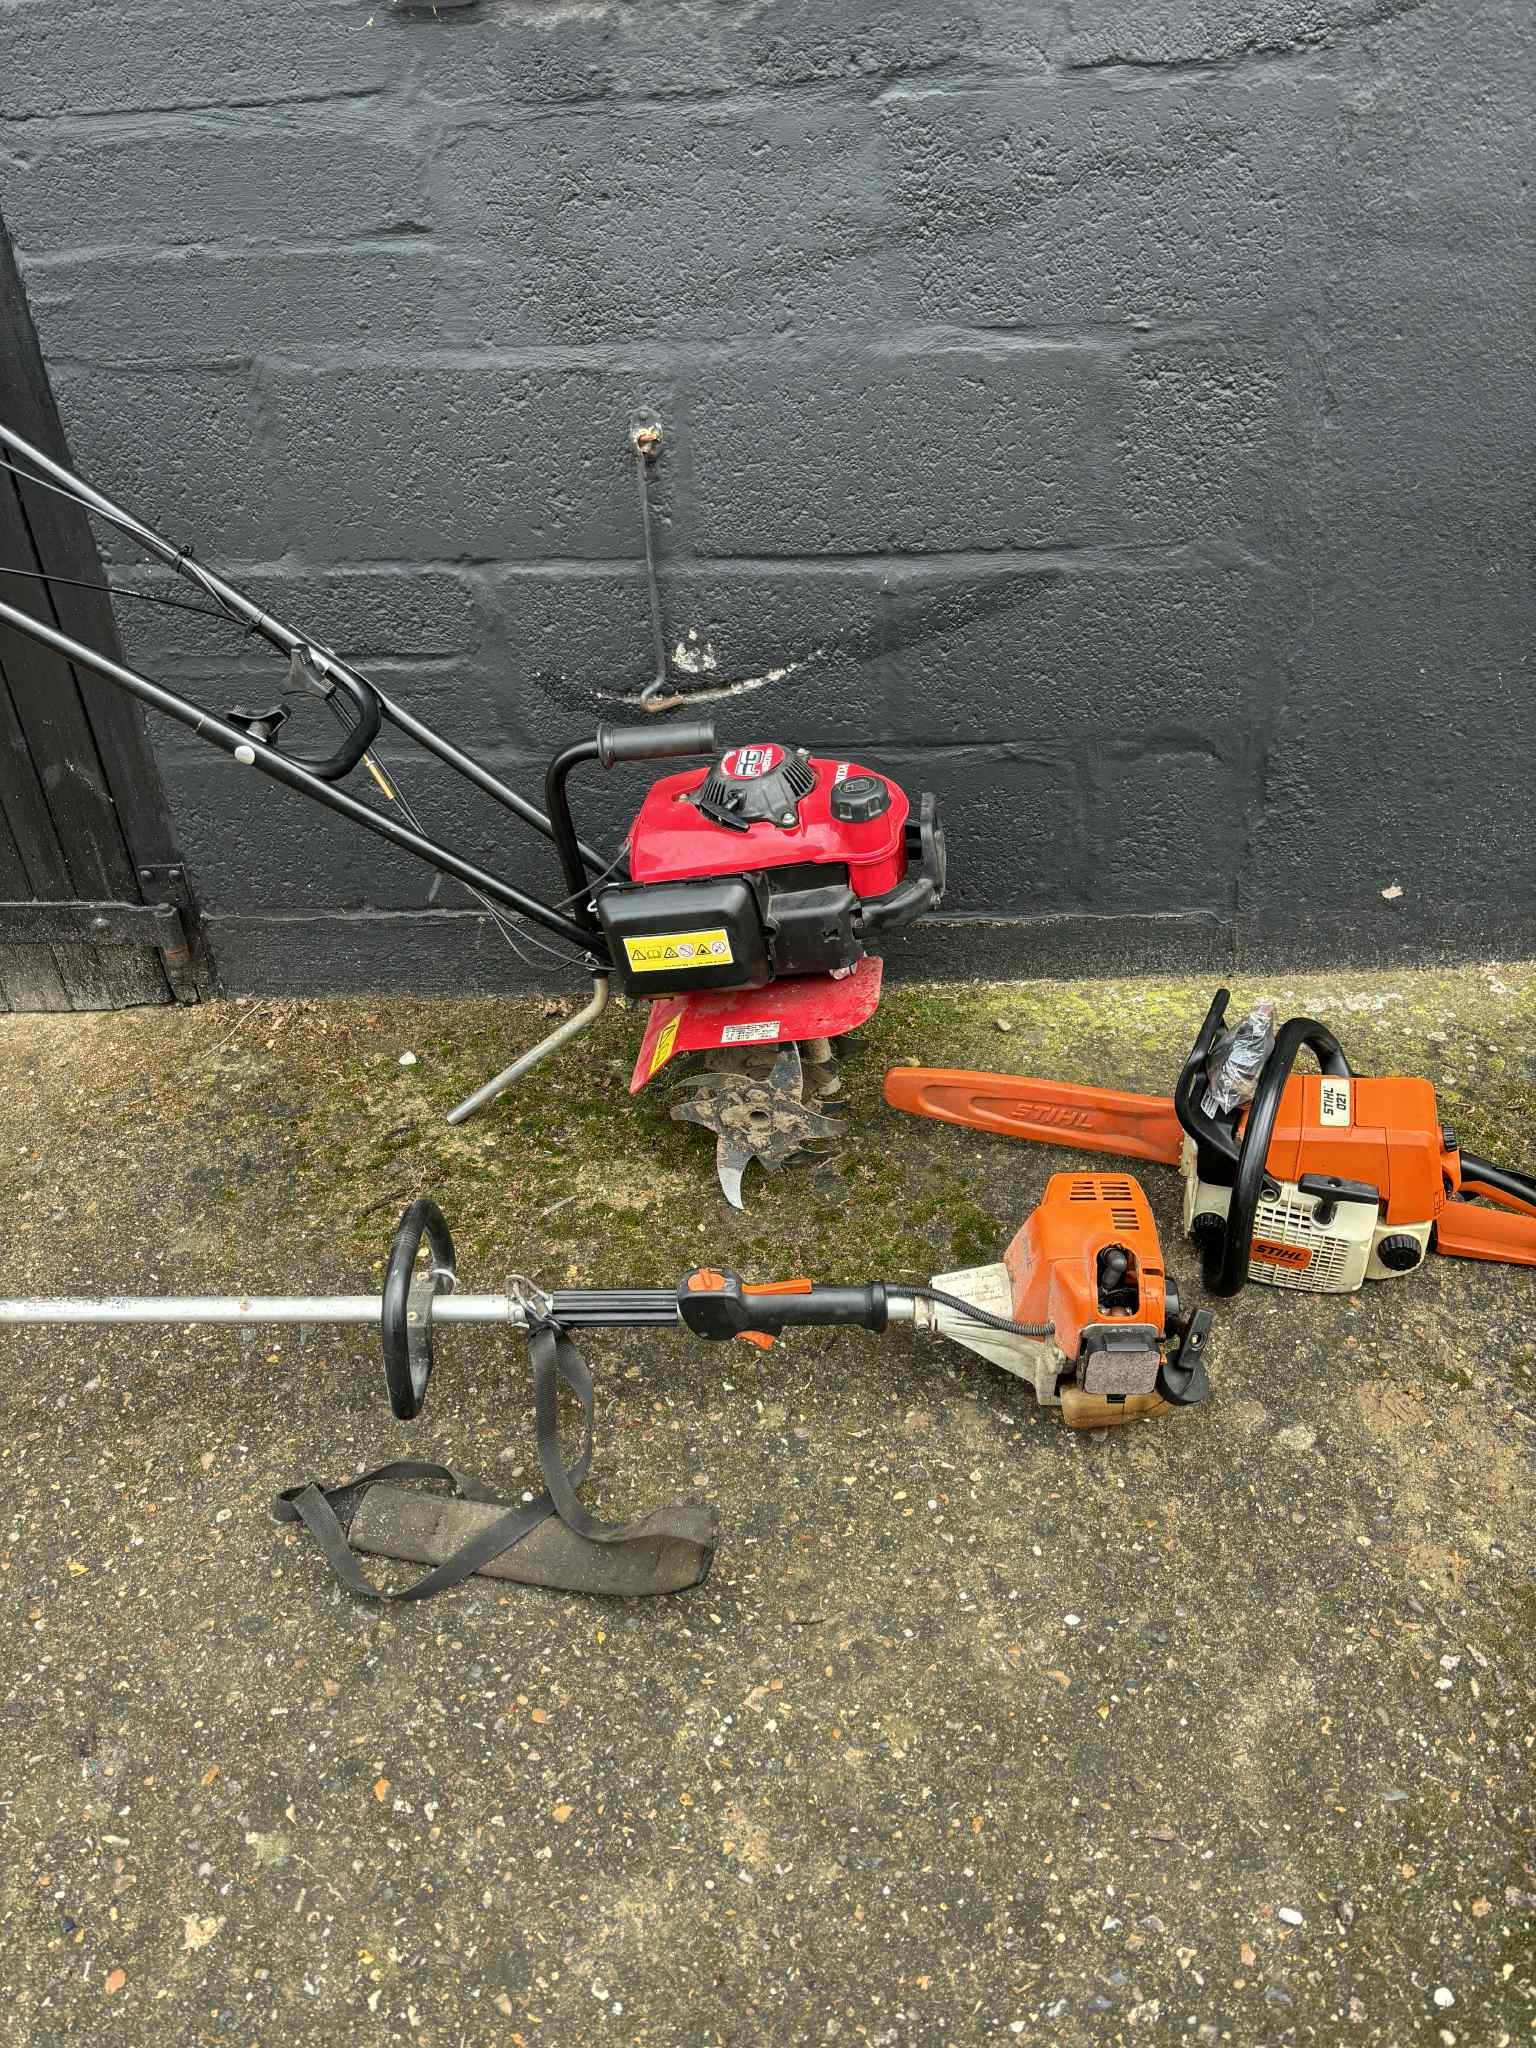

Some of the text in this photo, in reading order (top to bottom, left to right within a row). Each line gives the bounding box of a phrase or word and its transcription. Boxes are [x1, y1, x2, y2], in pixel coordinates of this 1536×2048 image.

[1323, 1087, 1334, 1116] STIHL
[1336, 1092, 1347, 1111] 021
[1010, 1103, 1095, 1129] STIHL
[1253, 1244, 1305, 1262] STIHL
